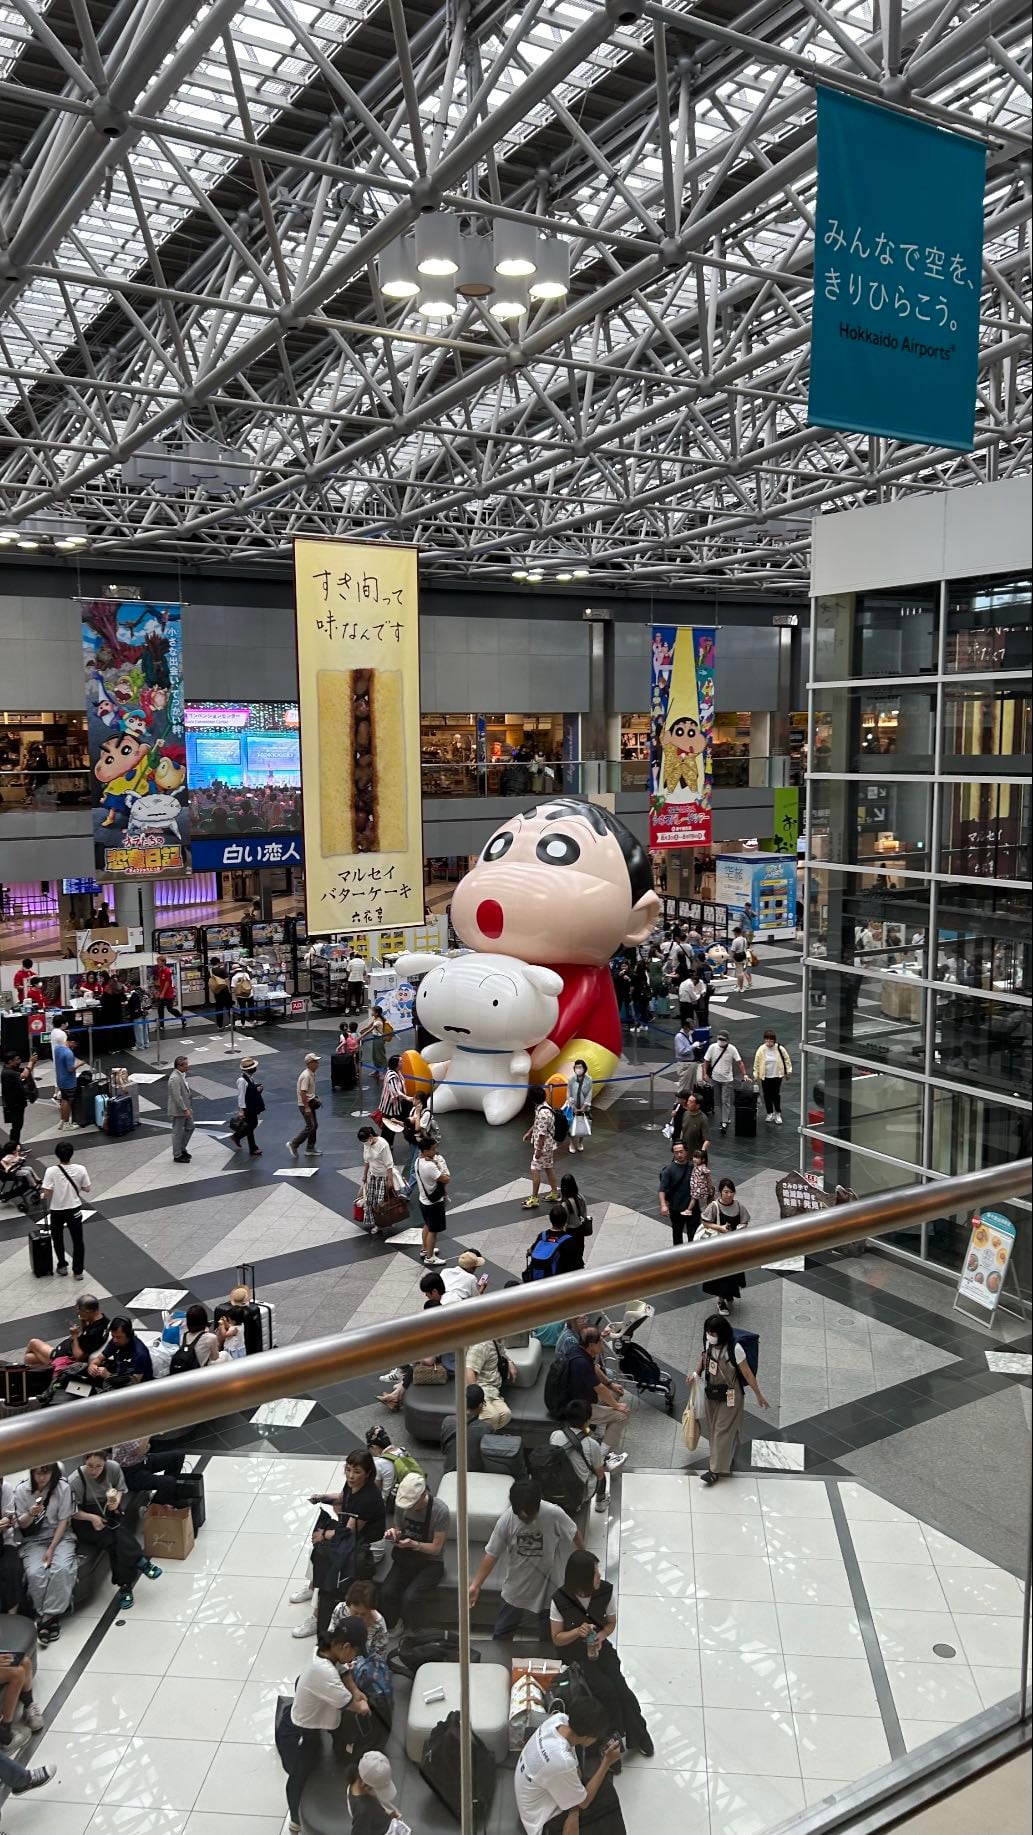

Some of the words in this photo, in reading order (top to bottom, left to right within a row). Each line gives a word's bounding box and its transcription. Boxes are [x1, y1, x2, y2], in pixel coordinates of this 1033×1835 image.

[823, 219, 975, 290] みんなで空を、
[823, 267, 958, 332] きりひらこう。
[839, 321, 899, 351] Hokkaido
[312, 569, 404, 607] すき間って
[316, 610, 405, 643] 味なんです
[222, 842, 300, 865] 白い恋人
[337, 865, 396, 884] マルセイ
[320, 883, 412, 905] バターケーキ
